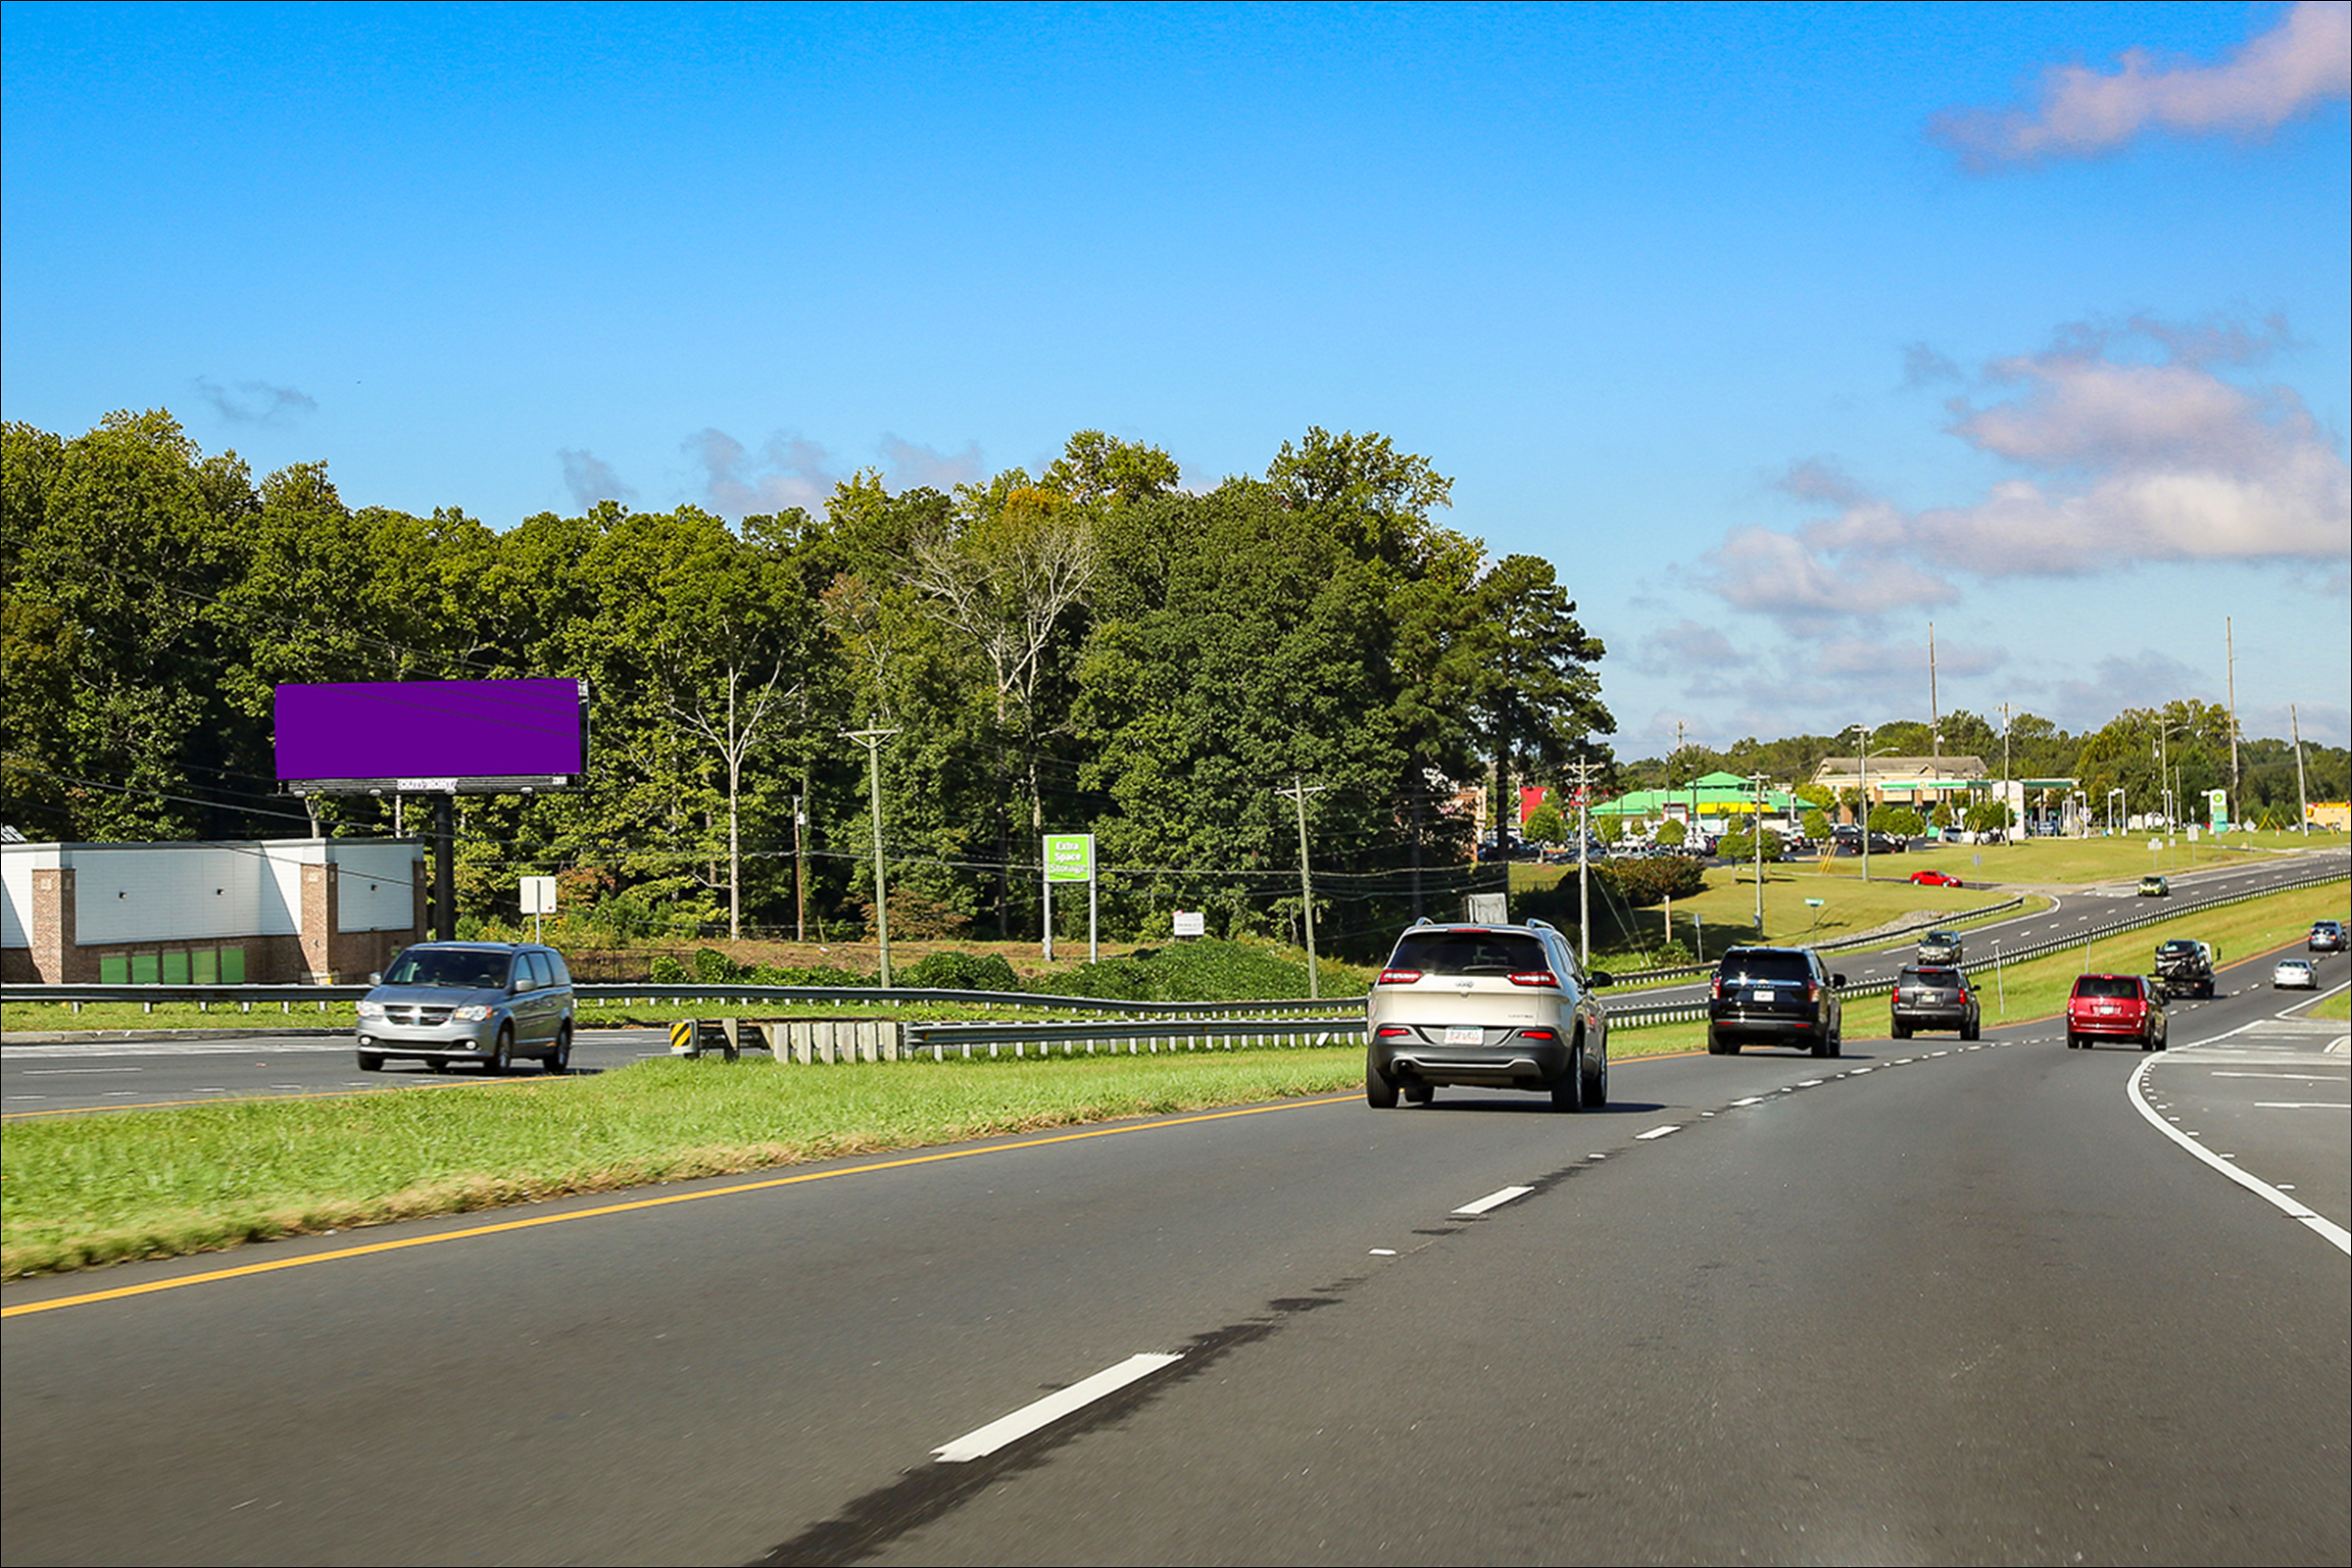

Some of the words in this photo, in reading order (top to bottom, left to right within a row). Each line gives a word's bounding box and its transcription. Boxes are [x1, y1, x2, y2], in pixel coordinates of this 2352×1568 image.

[1055, 842, 1079, 851] Extra
[1054, 853, 1082, 863] Space
[1050, 863, 1087, 874] Storage
